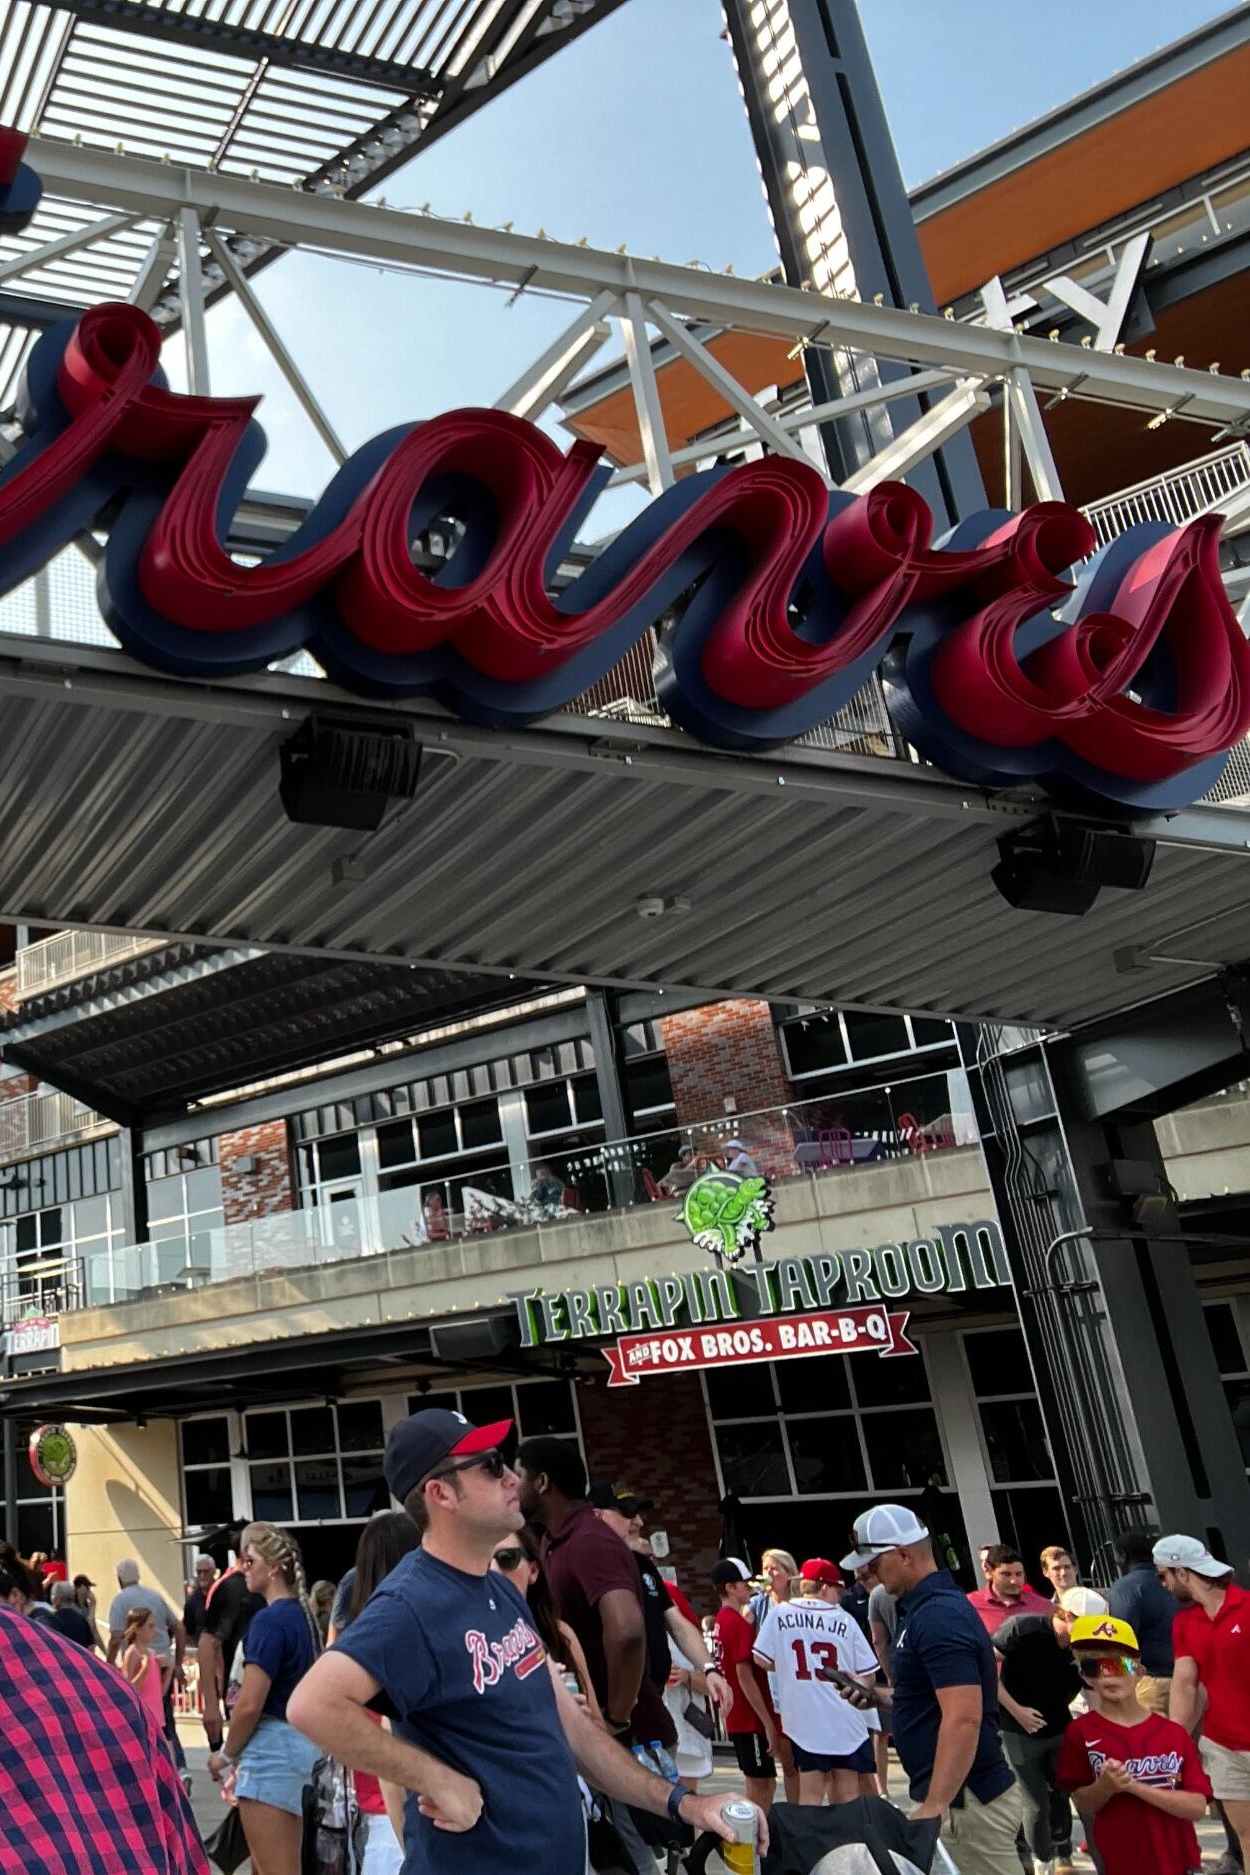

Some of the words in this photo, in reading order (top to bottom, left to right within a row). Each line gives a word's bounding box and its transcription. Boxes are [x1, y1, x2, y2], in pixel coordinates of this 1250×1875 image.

[506, 1270, 738, 1348] TERRAPIN
[742, 1220, 1013, 1314] TAPROOM
[628, 1345, 650, 1363] AND
[651, 1336, 696, 1365] FOX
[700, 1328, 772, 1360] BROS.
[778, 1313, 887, 1350] BAR-B-Q
[828, 1620, 848, 1640] JR.
[792, 1638, 839, 1682] 13
[1087, 1750, 1184, 1778] Baves
